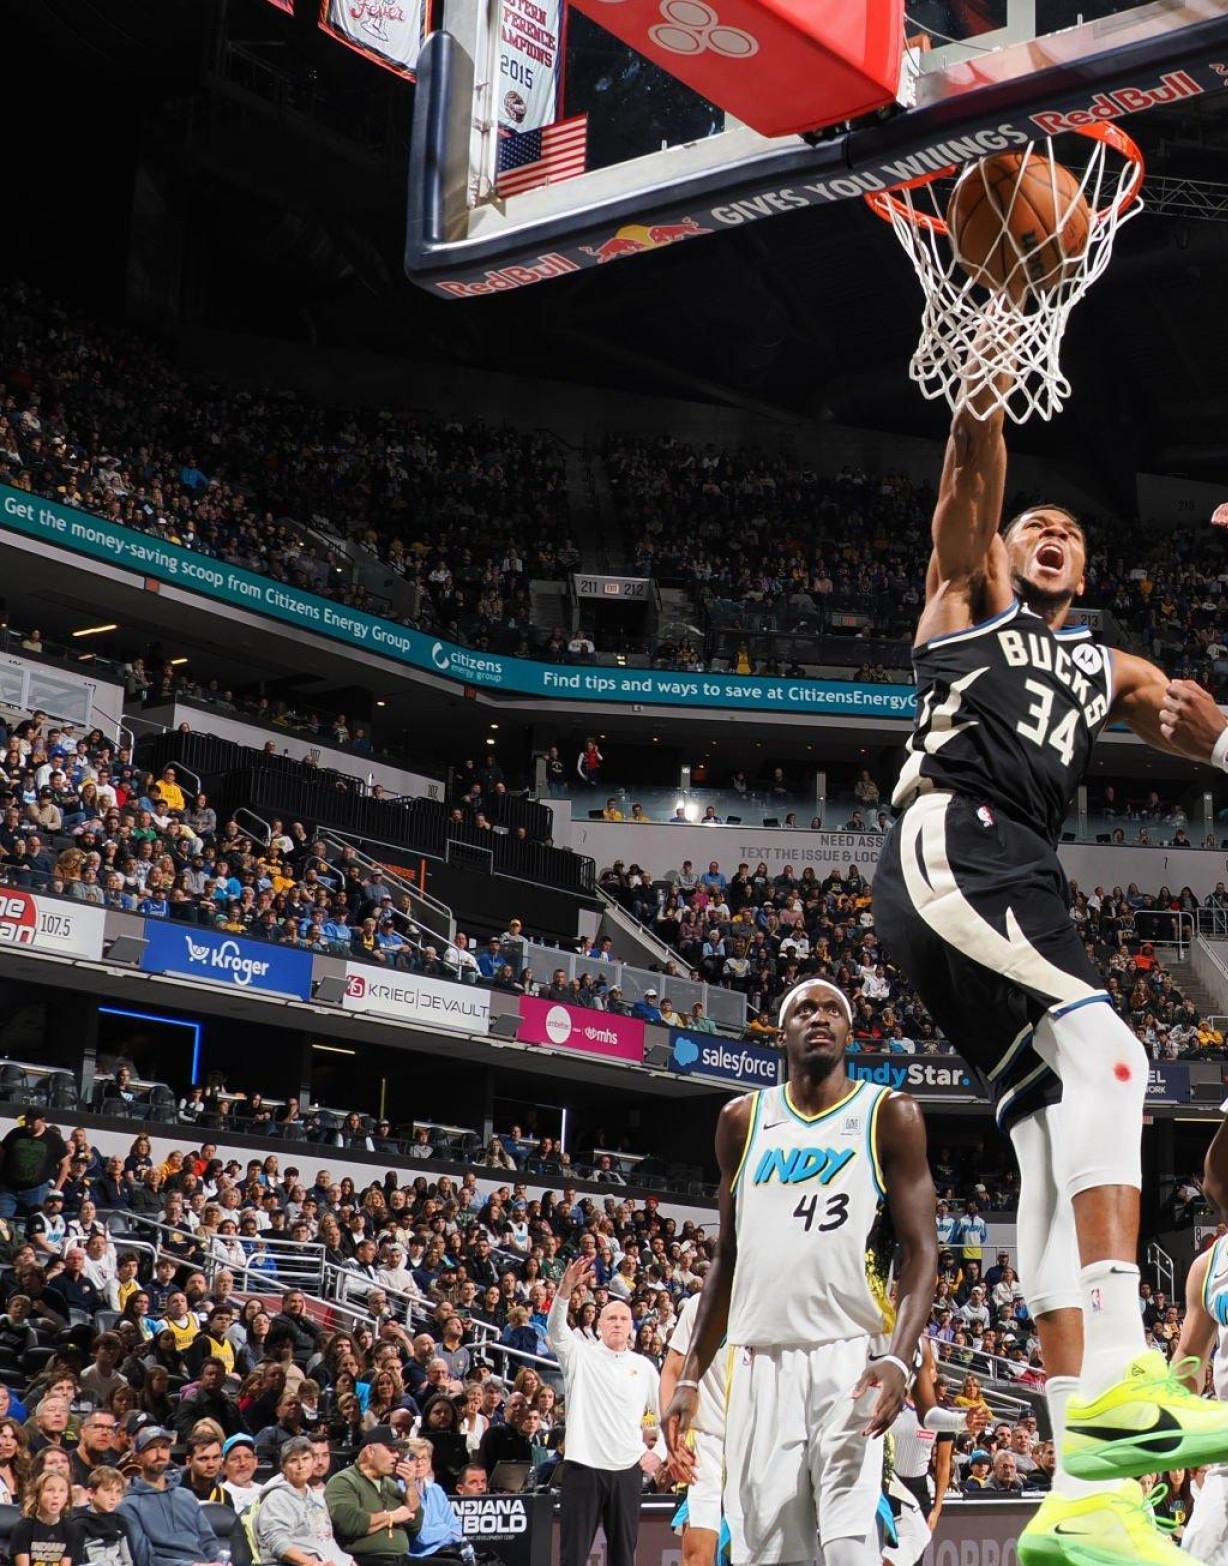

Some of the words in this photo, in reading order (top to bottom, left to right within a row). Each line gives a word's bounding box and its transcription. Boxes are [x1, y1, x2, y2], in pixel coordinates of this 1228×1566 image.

[500, 54, 534, 90] 2015
[711, 189, 810, 226] GIVES
[808, 168, 880, 205] YOU
[893, 123, 1030, 187] WIIINGS
[4, 496, 34, 521] Get
[39, 509, 67, 532] the
[71, 522, 178, 574] money-saving
[181, 560, 224, 587] scoop
[228, 575, 261, 599] from
[265, 587, 320, 619] Citizens
[323, 608, 369, 639] Energy
[372, 626, 410, 652] Group
[580, 580, 598, 593] 211
[624, 582, 644, 596] 212
[450, 650, 502, 673] citizens
[543, 671, 580, 689] Find
[585, 675, 616, 691] tips
[621, 678, 652, 692] and
[657, 682, 698, 697] ways
[703, 683, 720, 696] to
[725, 686, 762, 700] save
[767, 686, 783, 700] at
[997, 630, 1107, 730] BUCKS
[1016, 678, 1081, 767] 34
[739, 847, 772, 859] TEXT
[774, 848, 800, 860] THE
[801, 849, 840, 862] ISSUE
[820, 834, 855, 847] NEED
[40, 914, 71, 937] 107.5
[210, 940, 270, 986] Kroger
[596, 1028, 618, 1045] mhs
[702, 1046, 776, 1079] salesforce
[753, 1146, 859, 1186] INDY
[792, 1193, 850, 1233] 43
[450, 1499, 526, 1515] NDIANA
[463, 1515, 528, 1534] BOLD
